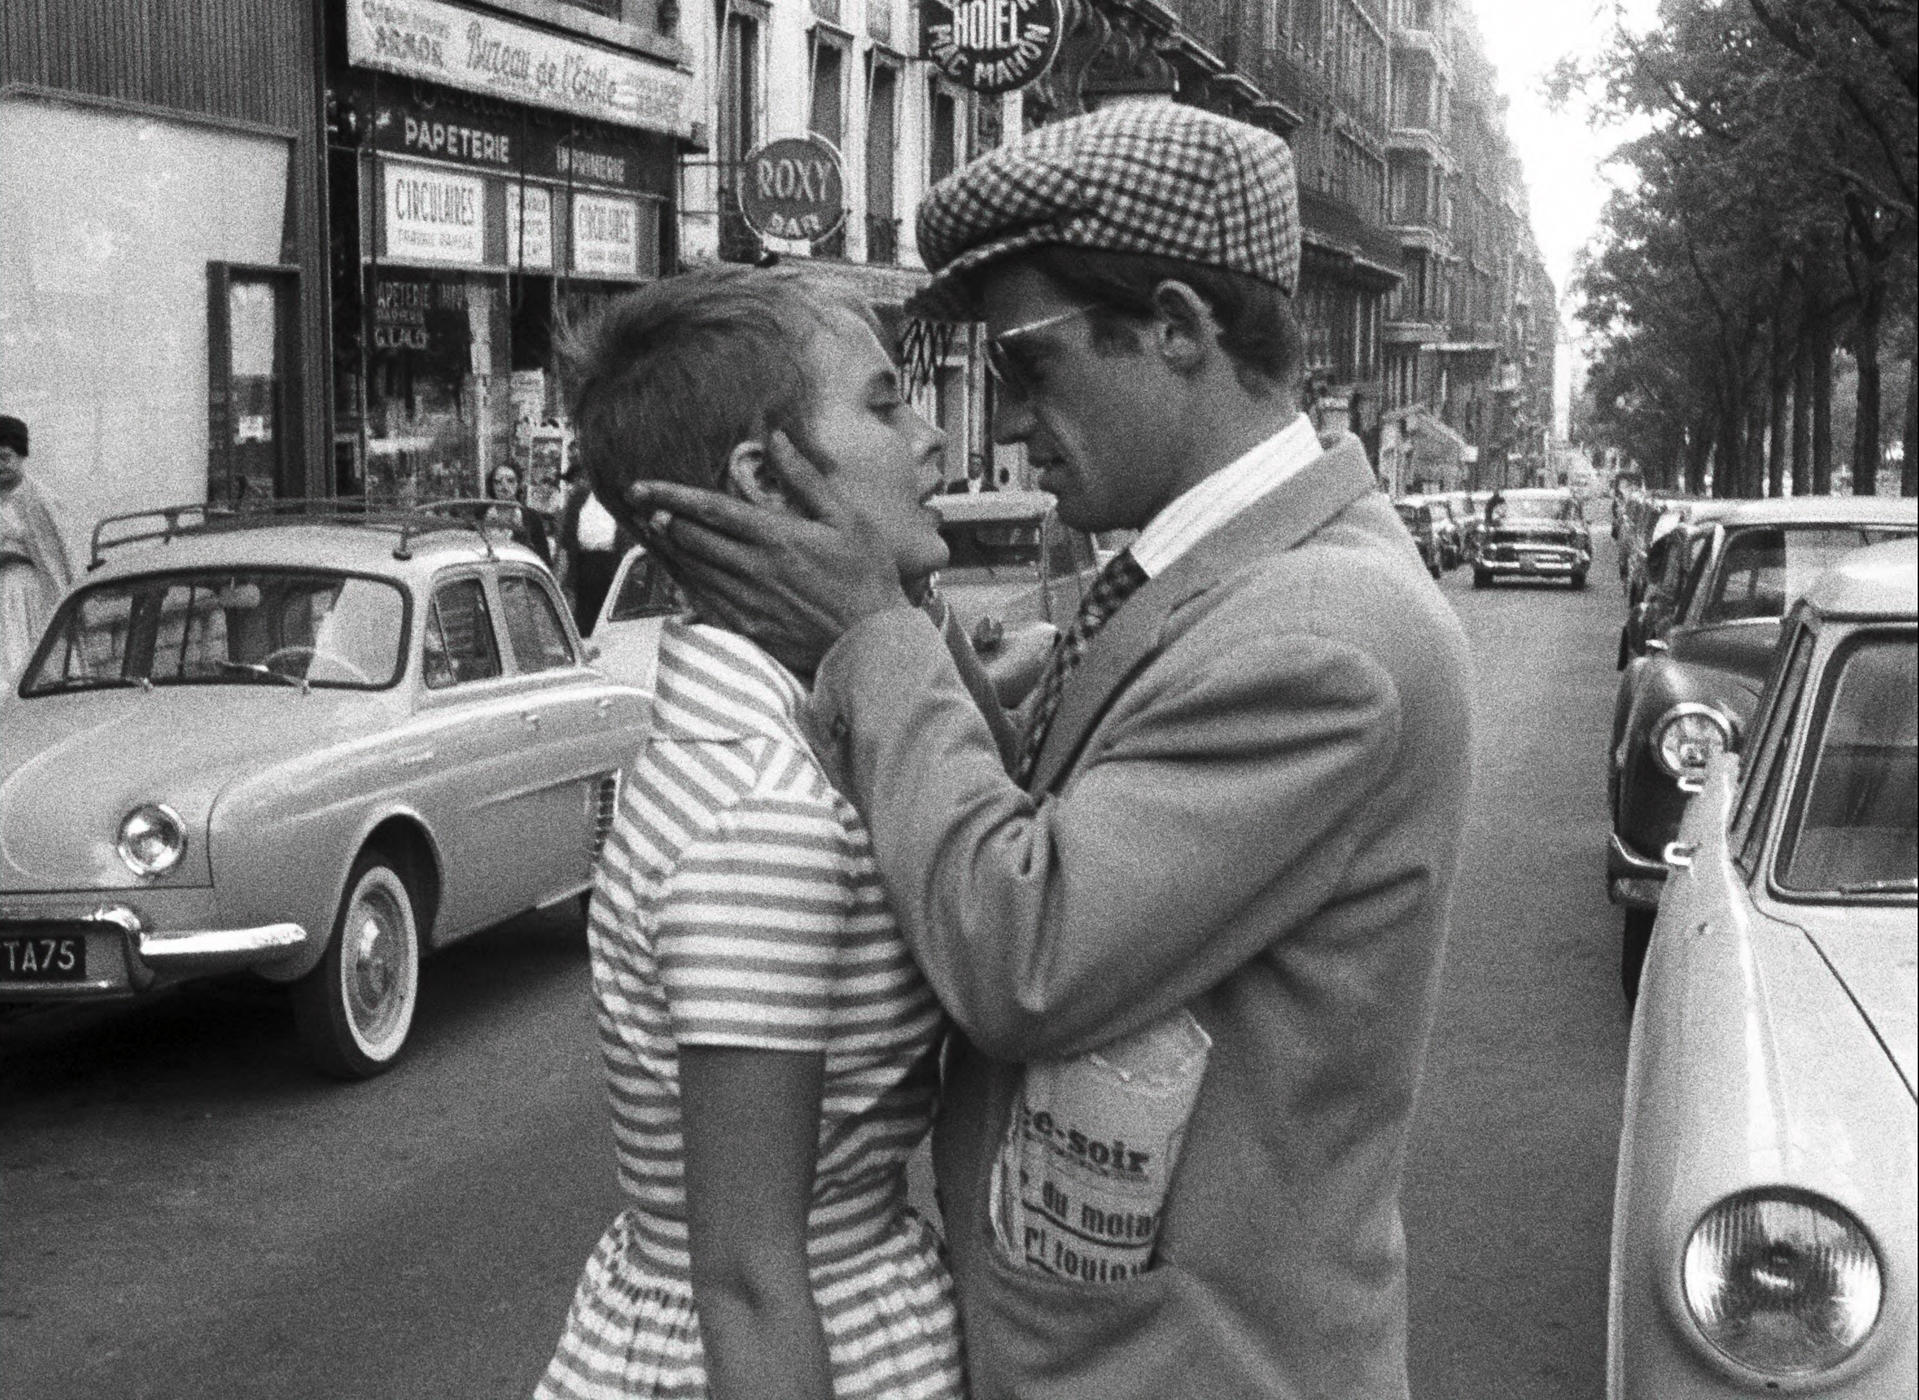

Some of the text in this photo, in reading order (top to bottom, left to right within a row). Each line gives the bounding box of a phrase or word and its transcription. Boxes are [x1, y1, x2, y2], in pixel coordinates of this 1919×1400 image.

[536, 51, 557, 90] de
[928, 24, 969, 76] MAC
[404, 118, 509, 163] PAPETERIE
[395, 178, 475, 226] CIRCULAIRES
[757, 158, 832, 203] ROXY
[4, 940, 75, 972] TA75
